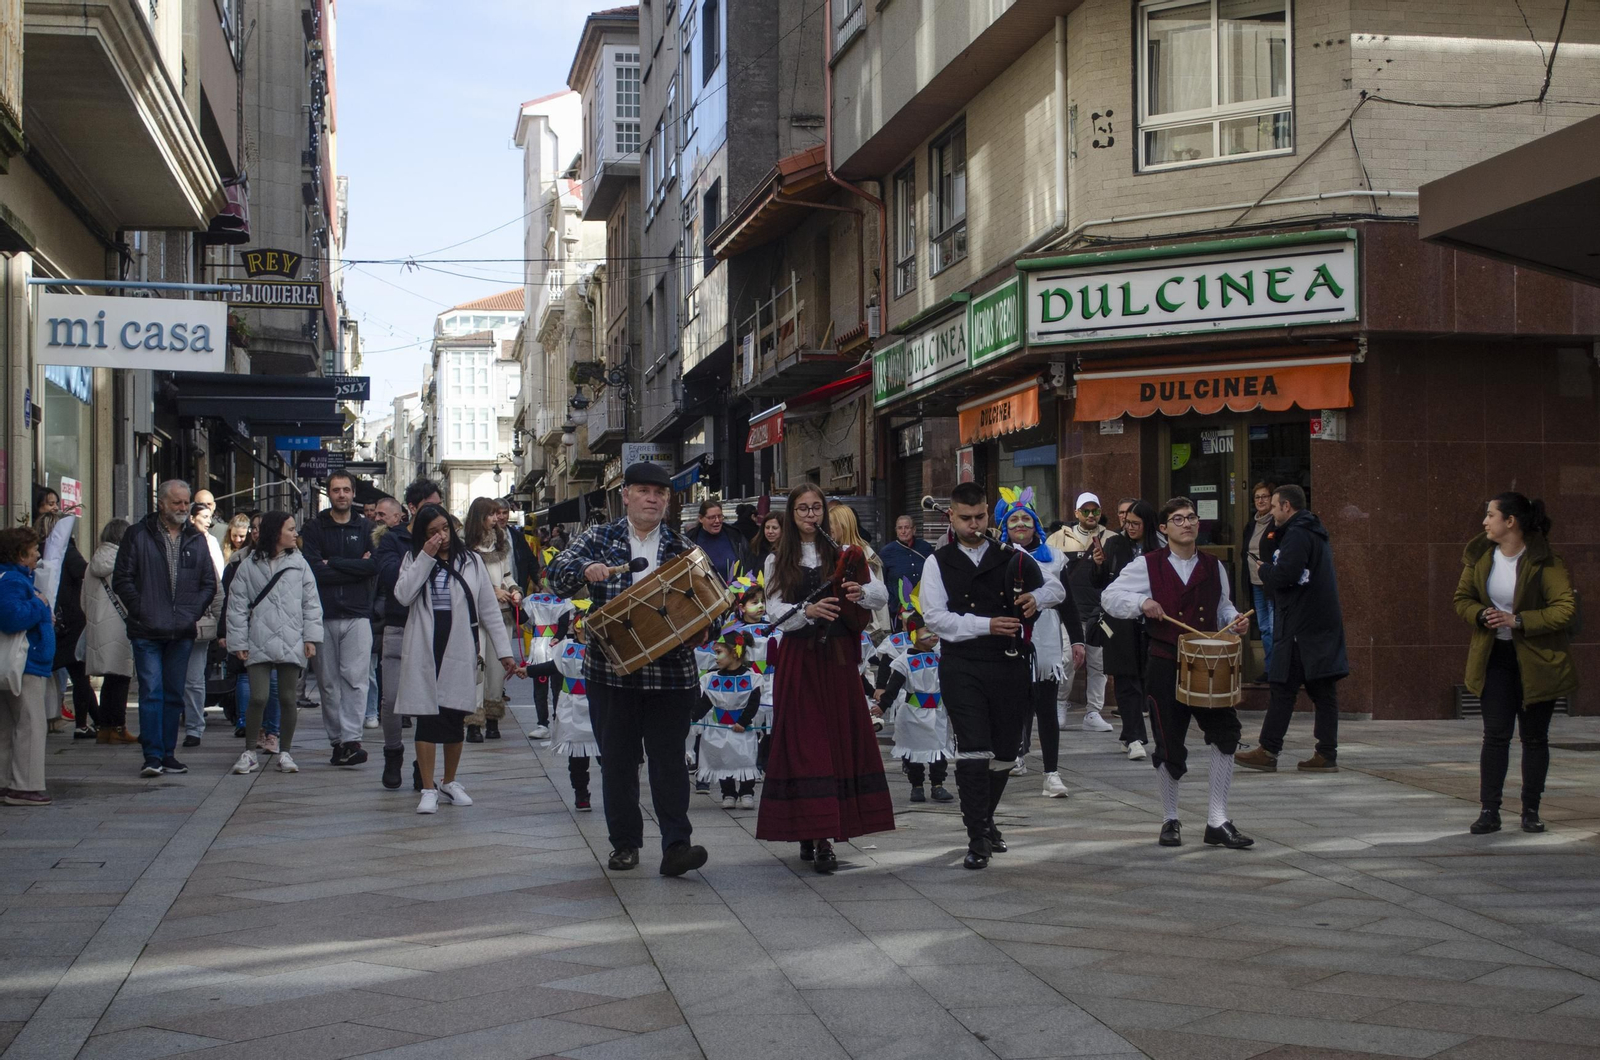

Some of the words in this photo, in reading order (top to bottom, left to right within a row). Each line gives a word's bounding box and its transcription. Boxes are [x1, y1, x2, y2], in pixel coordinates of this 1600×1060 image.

[247, 252, 298, 273] REY
[222, 283, 319, 304] PELUQUERIA
[1037, 263, 1344, 323] DULCINEA
[47, 310, 108, 348] mi
[120, 321, 214, 353] casa
[974, 306, 994, 353] MENOS
[907, 322, 966, 376] DULCINEA
[1140, 375, 1278, 401] DULCINEA
[1211, 437, 1234, 454] NON
